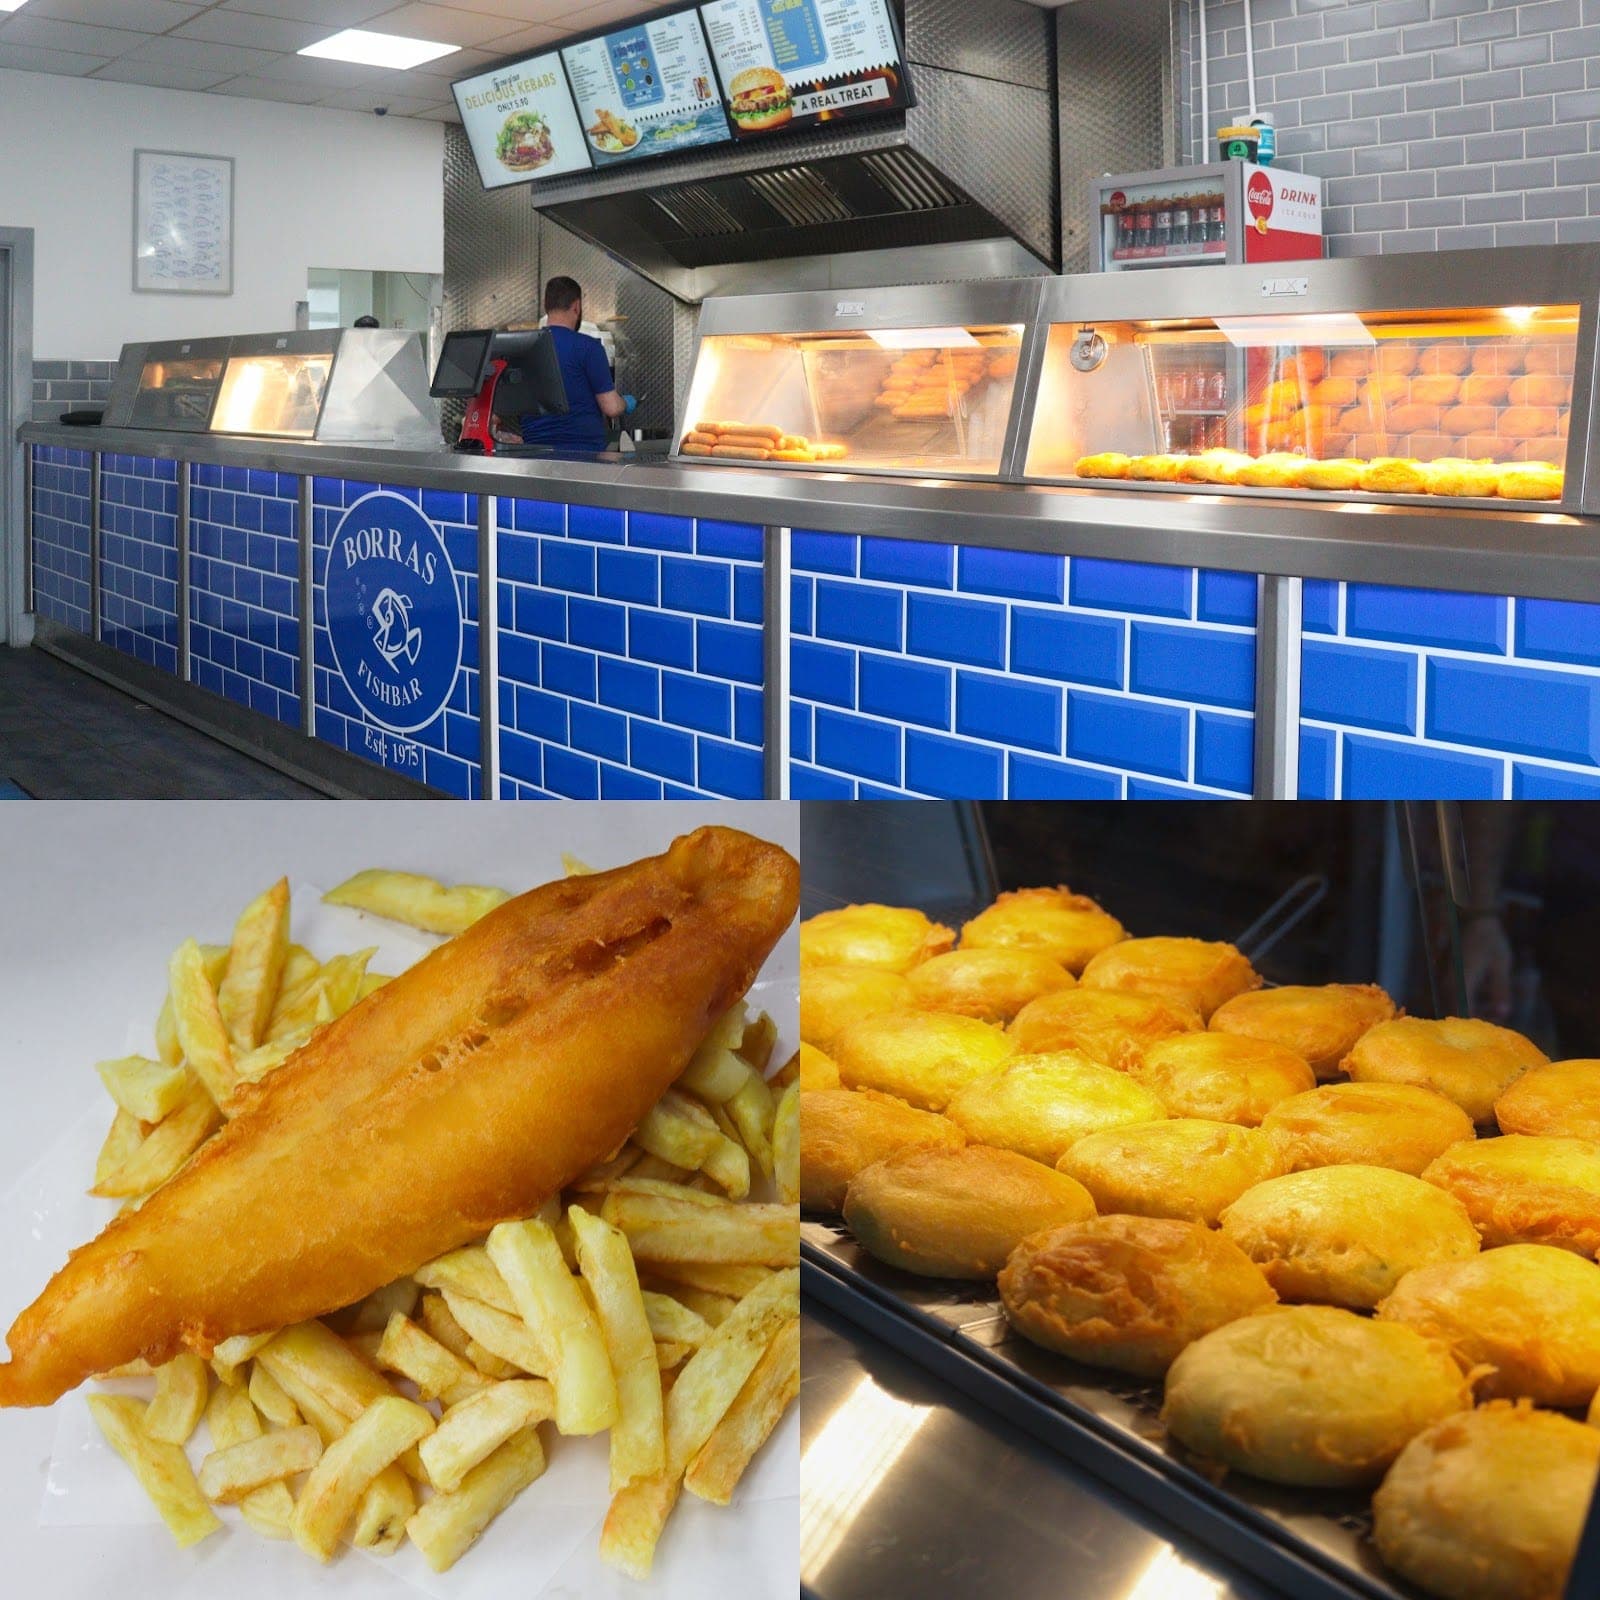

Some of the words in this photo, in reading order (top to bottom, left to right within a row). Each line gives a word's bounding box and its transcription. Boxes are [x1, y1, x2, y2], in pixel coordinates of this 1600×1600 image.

[464, 84, 515, 110] DELICIOUS
[516, 72, 557, 95] KEBABS
[801, 99, 809, 111] A
[810, 94, 838, 109] REAL
[839, 85, 873, 102] TREAT
[497, 102, 513, 113] ONLY
[1280, 188, 1317, 206] DRINK
[342, 527, 438, 585] BORRAS
[357, 658, 423, 707] FISHBAR
[393, 743, 419, 766] 1975
